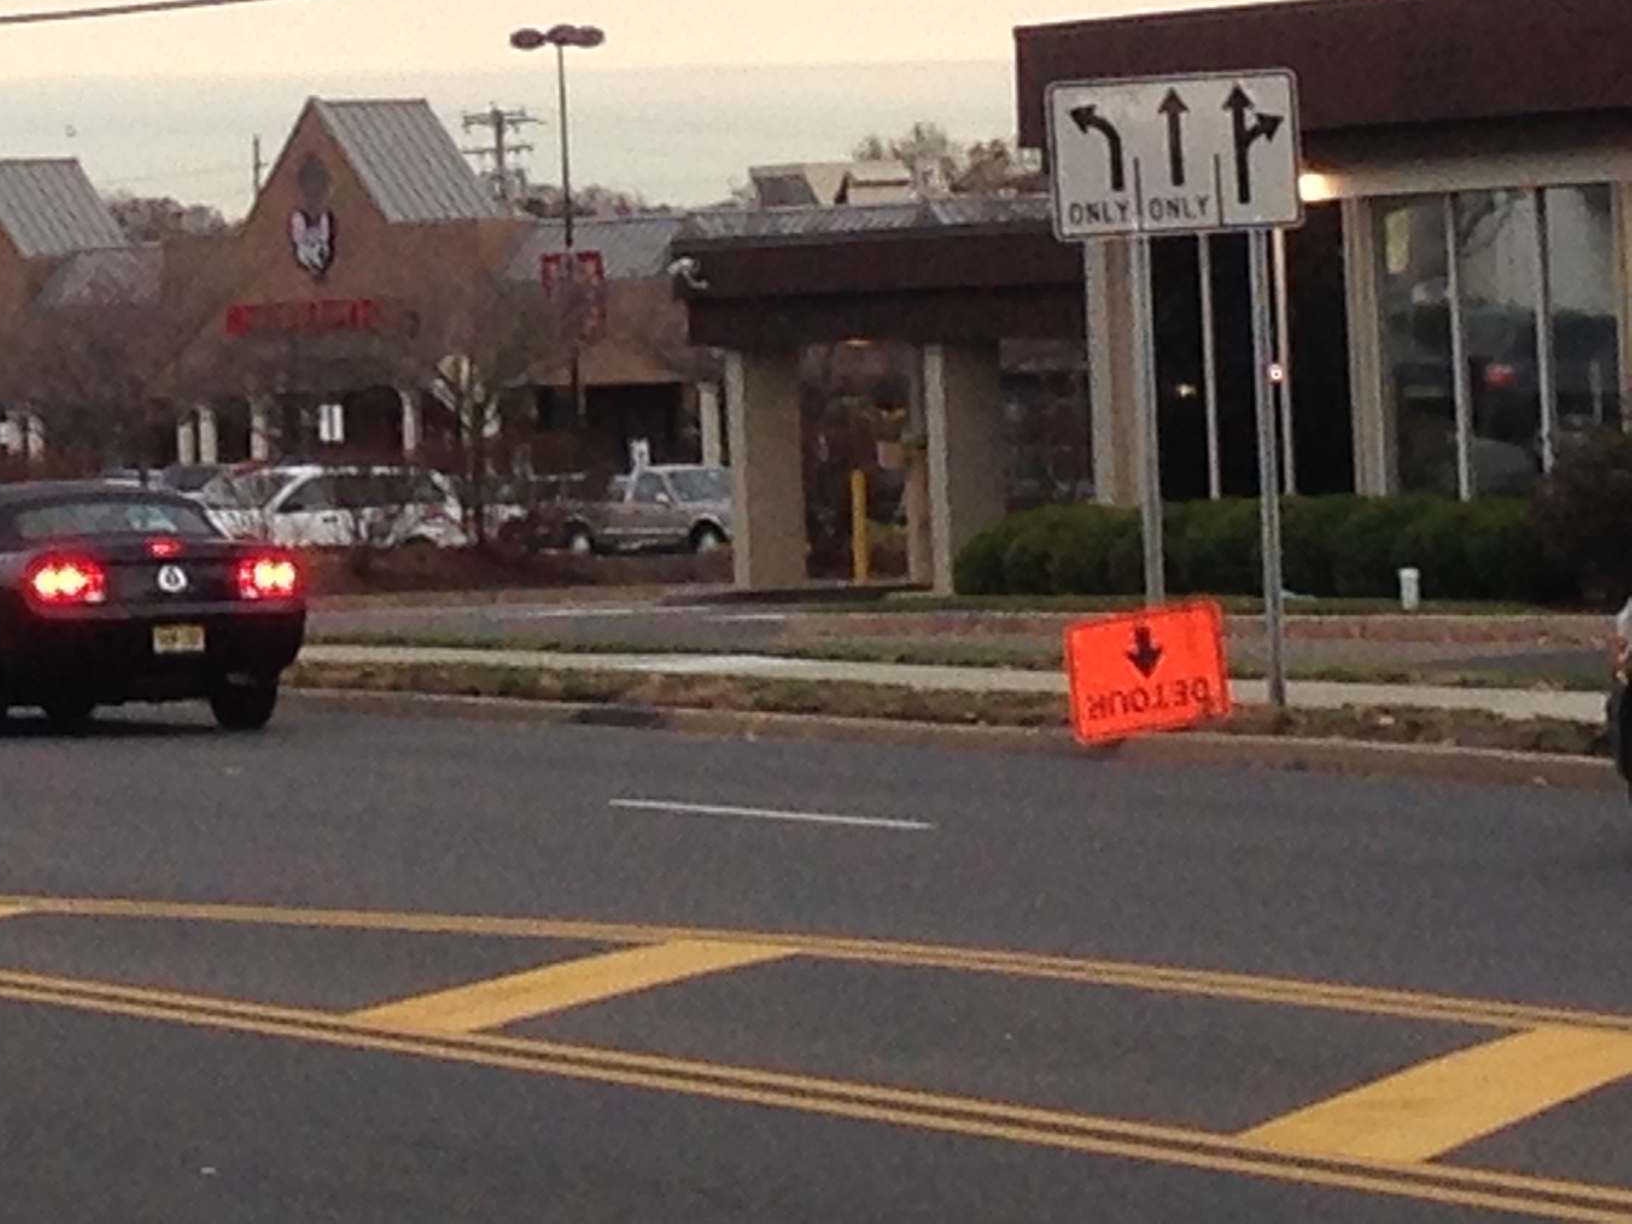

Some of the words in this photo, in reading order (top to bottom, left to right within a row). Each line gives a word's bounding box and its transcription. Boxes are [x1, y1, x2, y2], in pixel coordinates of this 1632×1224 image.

[1069, 203, 1130, 224] ONLY
[1149, 196, 1210, 220] ONLY
[1086, 676, 1210, 721] DETOUR
